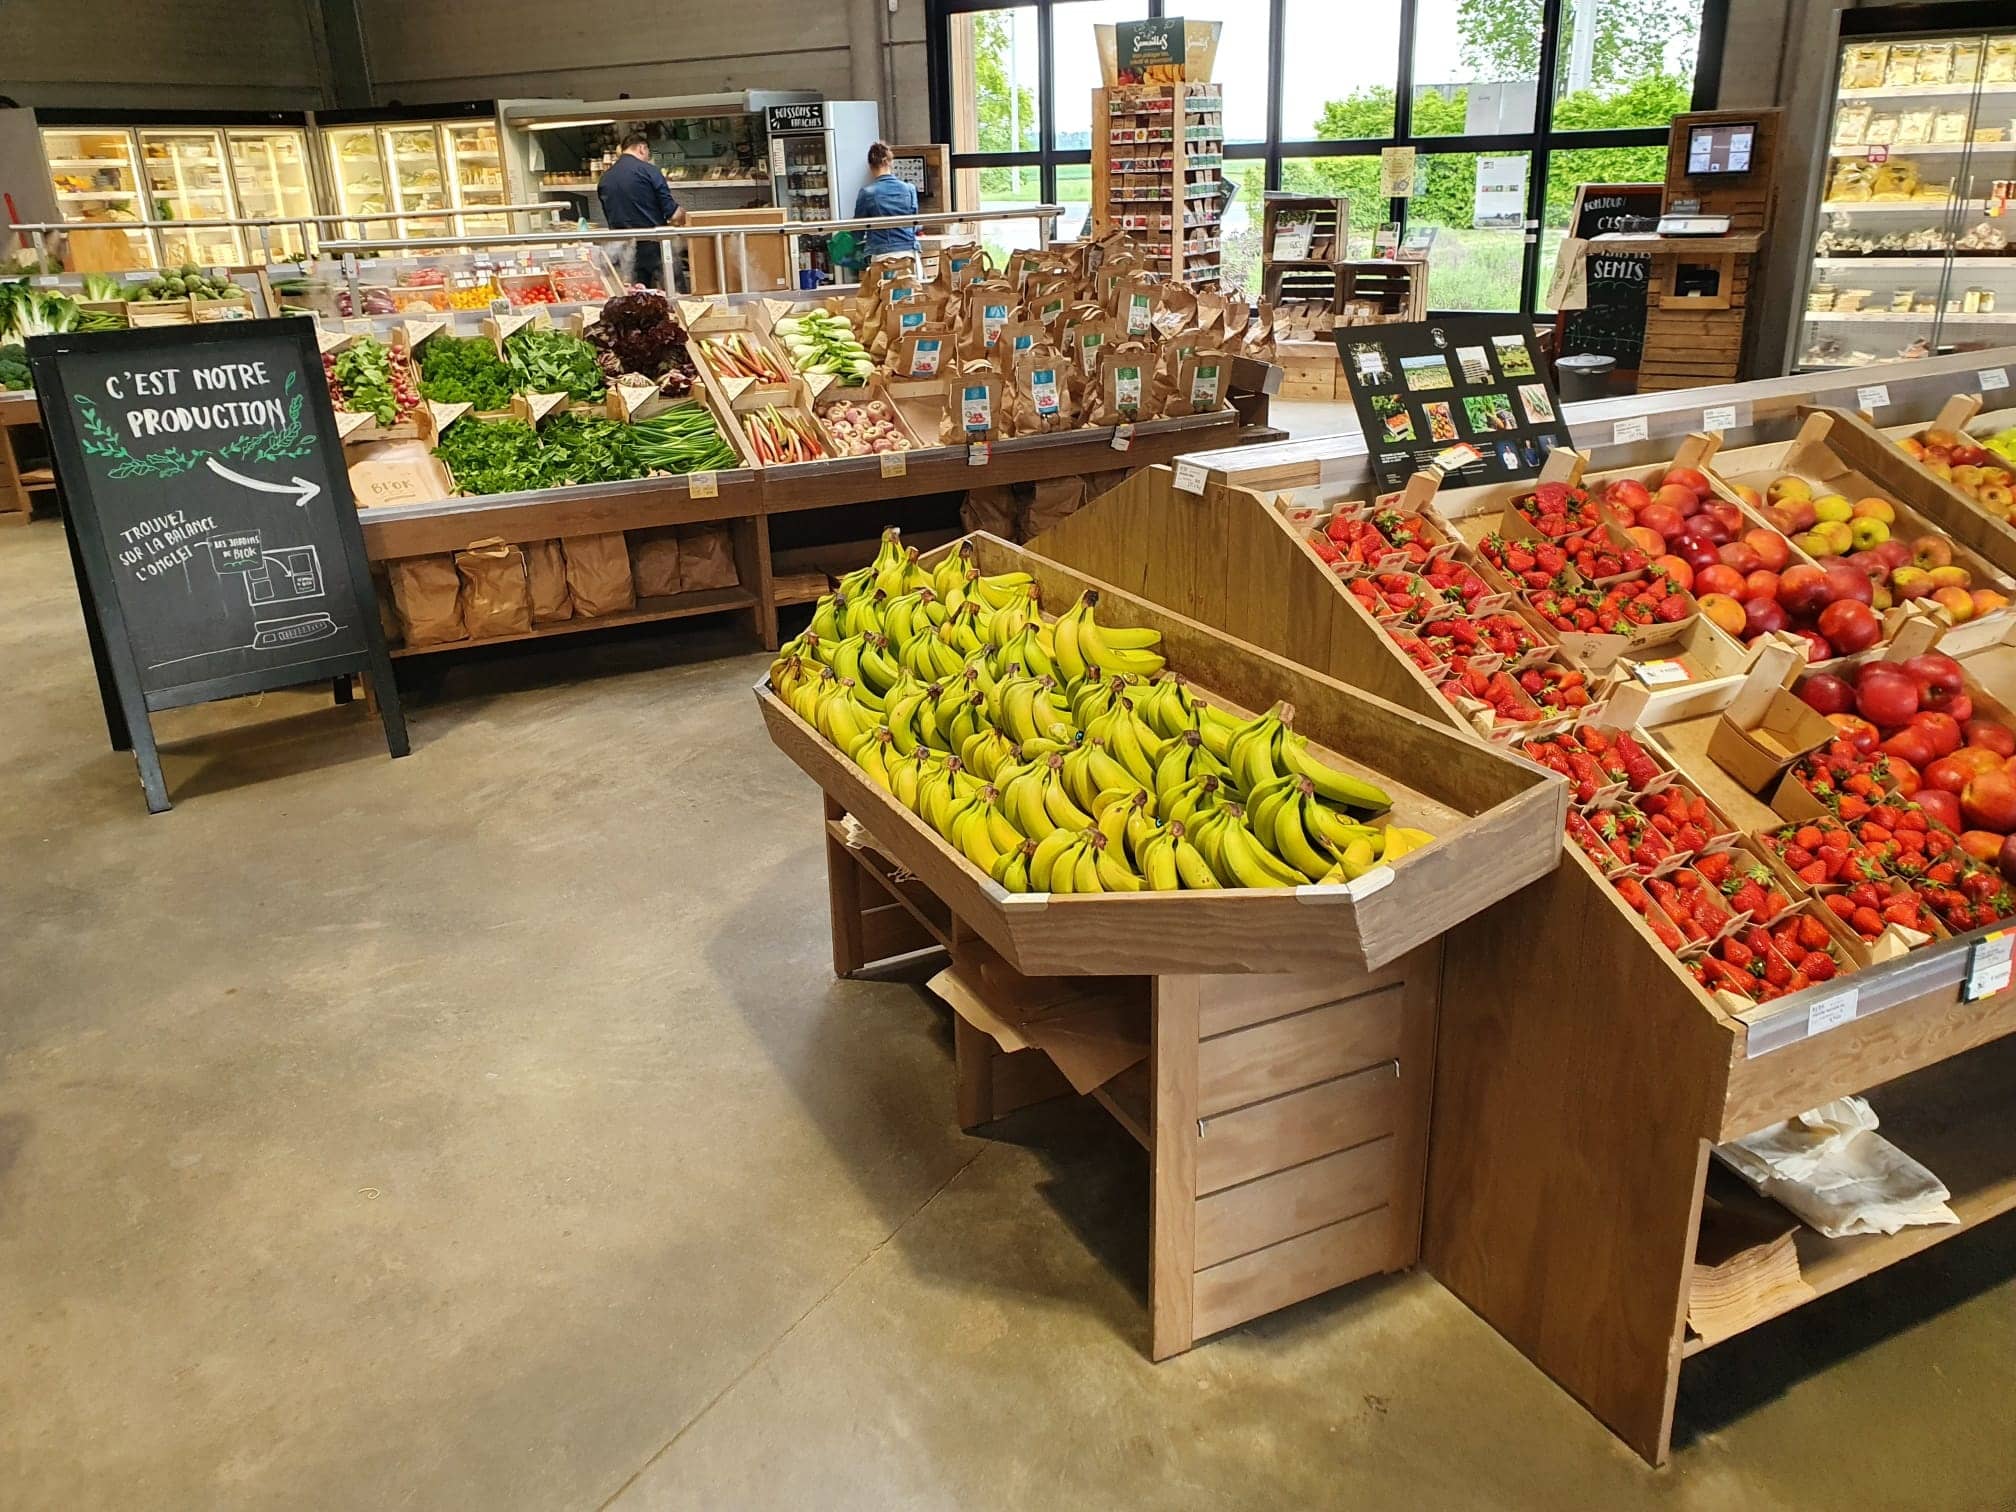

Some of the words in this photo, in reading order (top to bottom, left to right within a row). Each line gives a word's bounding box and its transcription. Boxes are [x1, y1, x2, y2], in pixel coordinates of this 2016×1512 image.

[1594, 260, 1645, 281] SEMIS
[106, 369, 181, 399] C'EST
[192, 362, 270, 391] NOTRE
[127, 398, 286, 438] PRODUCTION
[119, 545, 145, 566] SUR
[145, 535, 165, 556] LA
[164, 516, 218, 548] BALANCE
[120, 510, 187, 544] TROUVEZ
[135, 545, 194, 582] L'ONGLET
